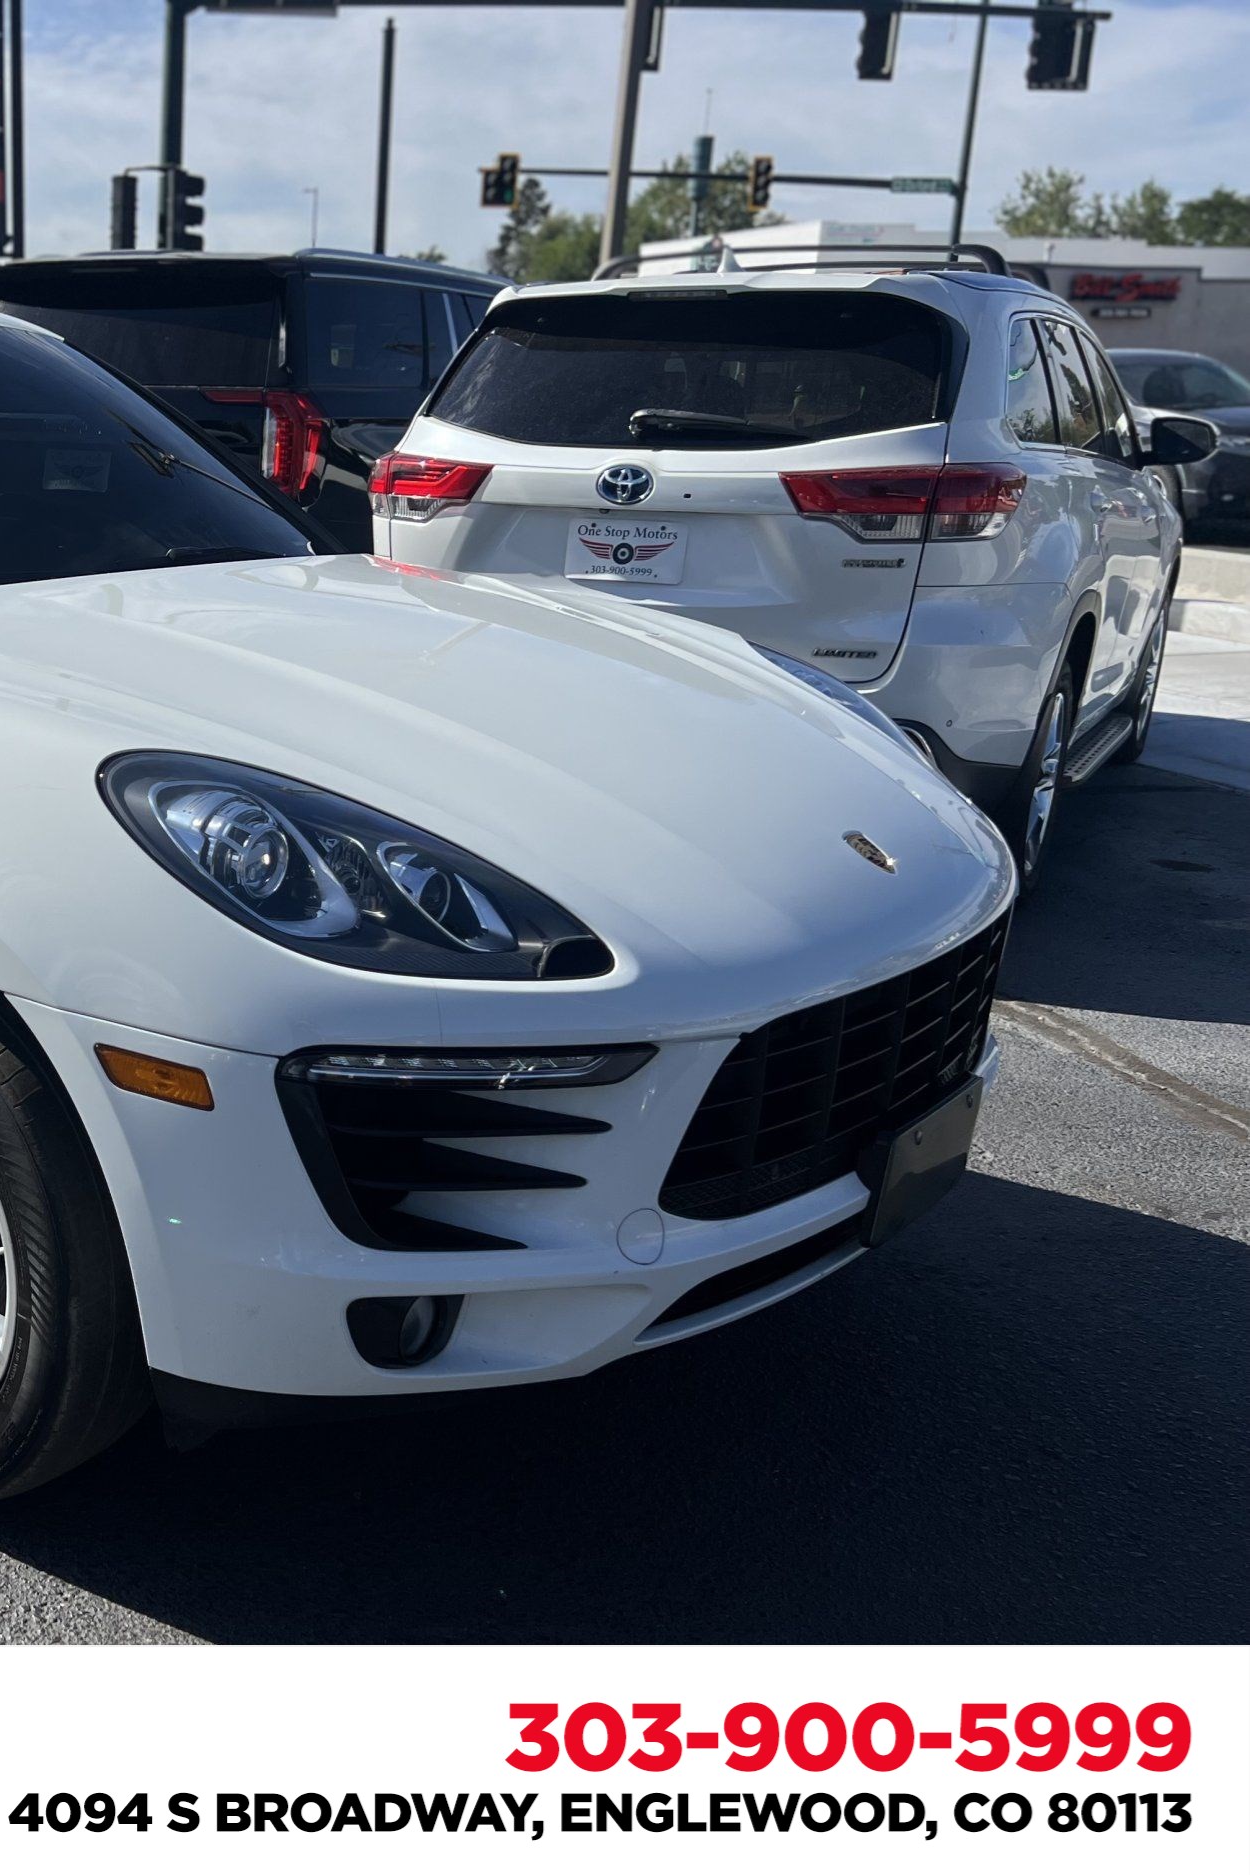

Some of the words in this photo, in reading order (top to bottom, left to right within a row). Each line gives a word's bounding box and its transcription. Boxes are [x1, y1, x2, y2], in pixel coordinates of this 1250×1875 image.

[578, 525, 602, 536] One
[604, 526, 630, 540] Stop
[633, 527, 678, 540] Motors
[591, 565, 653, 576] 303-900-5999
[814, 649, 877, 659] LIMITED
